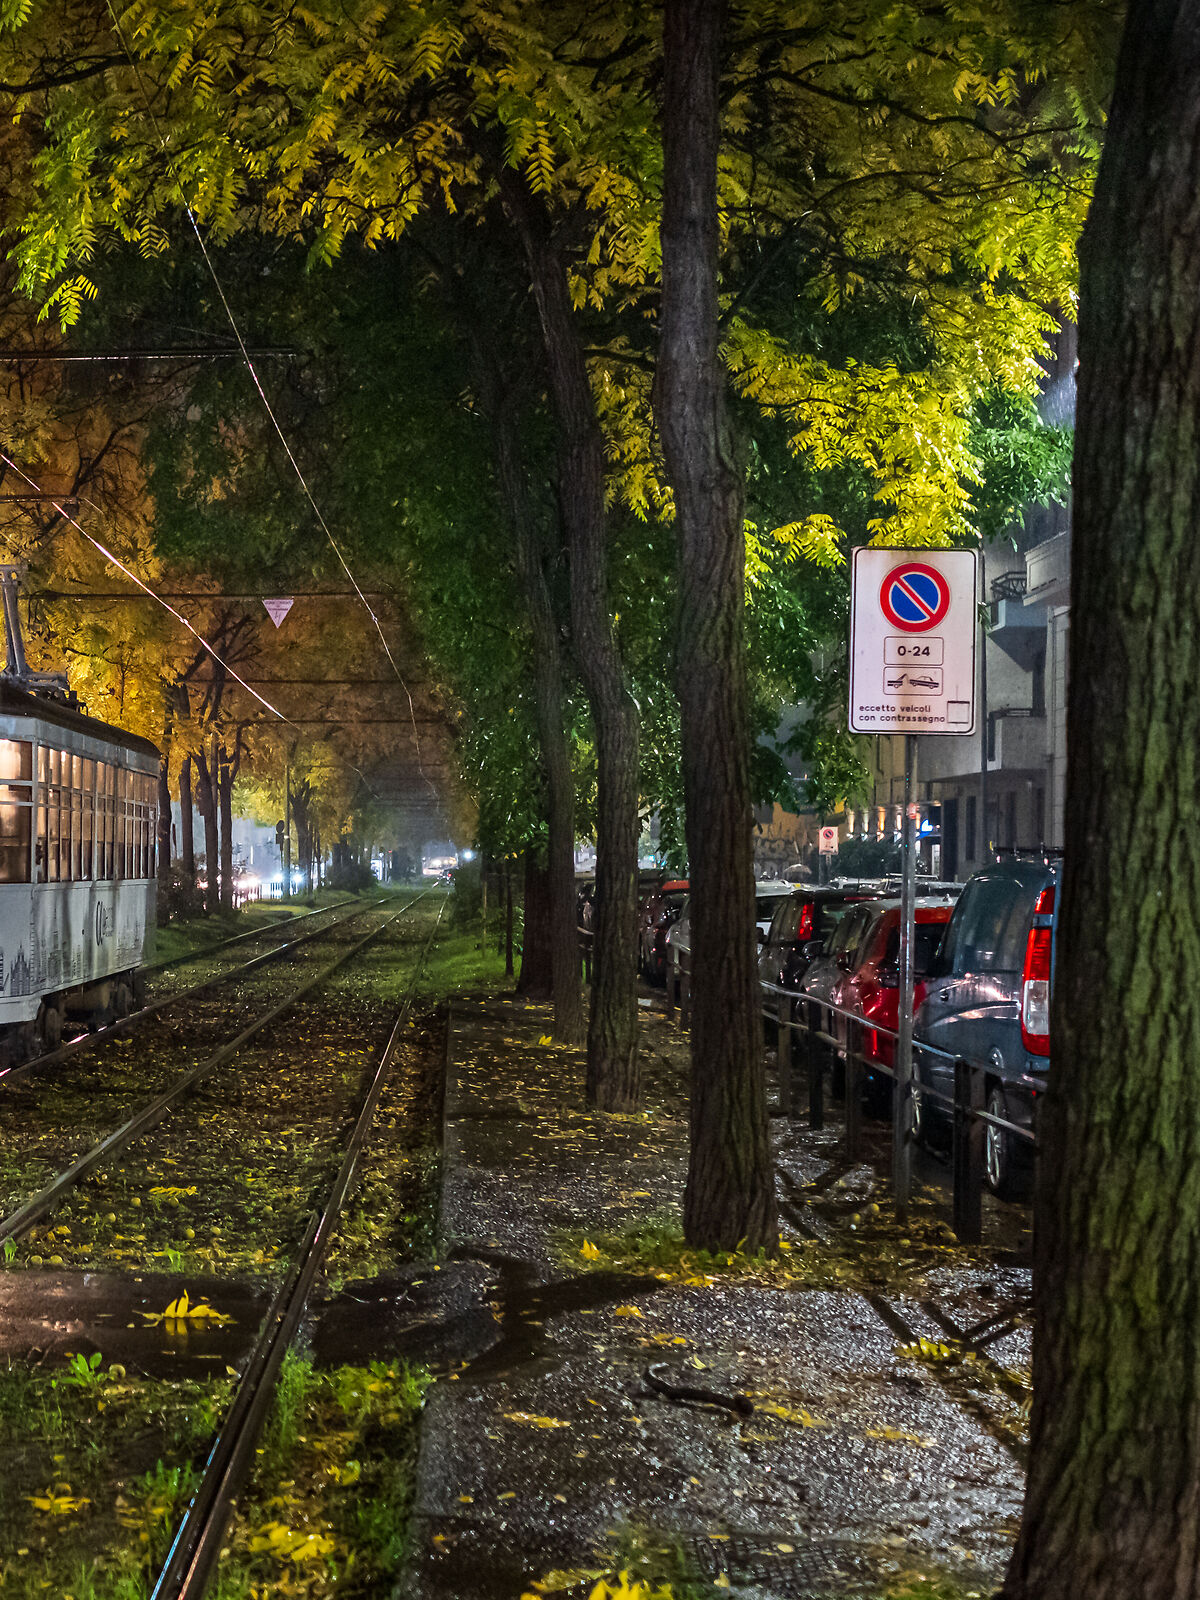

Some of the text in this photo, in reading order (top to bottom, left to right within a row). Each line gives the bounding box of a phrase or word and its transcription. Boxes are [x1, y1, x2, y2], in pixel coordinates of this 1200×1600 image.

[897, 645, 931, 657] 0-24
[859, 704, 931, 712] eccetto veicoli
[858, 713, 946, 723] con contrassegno
